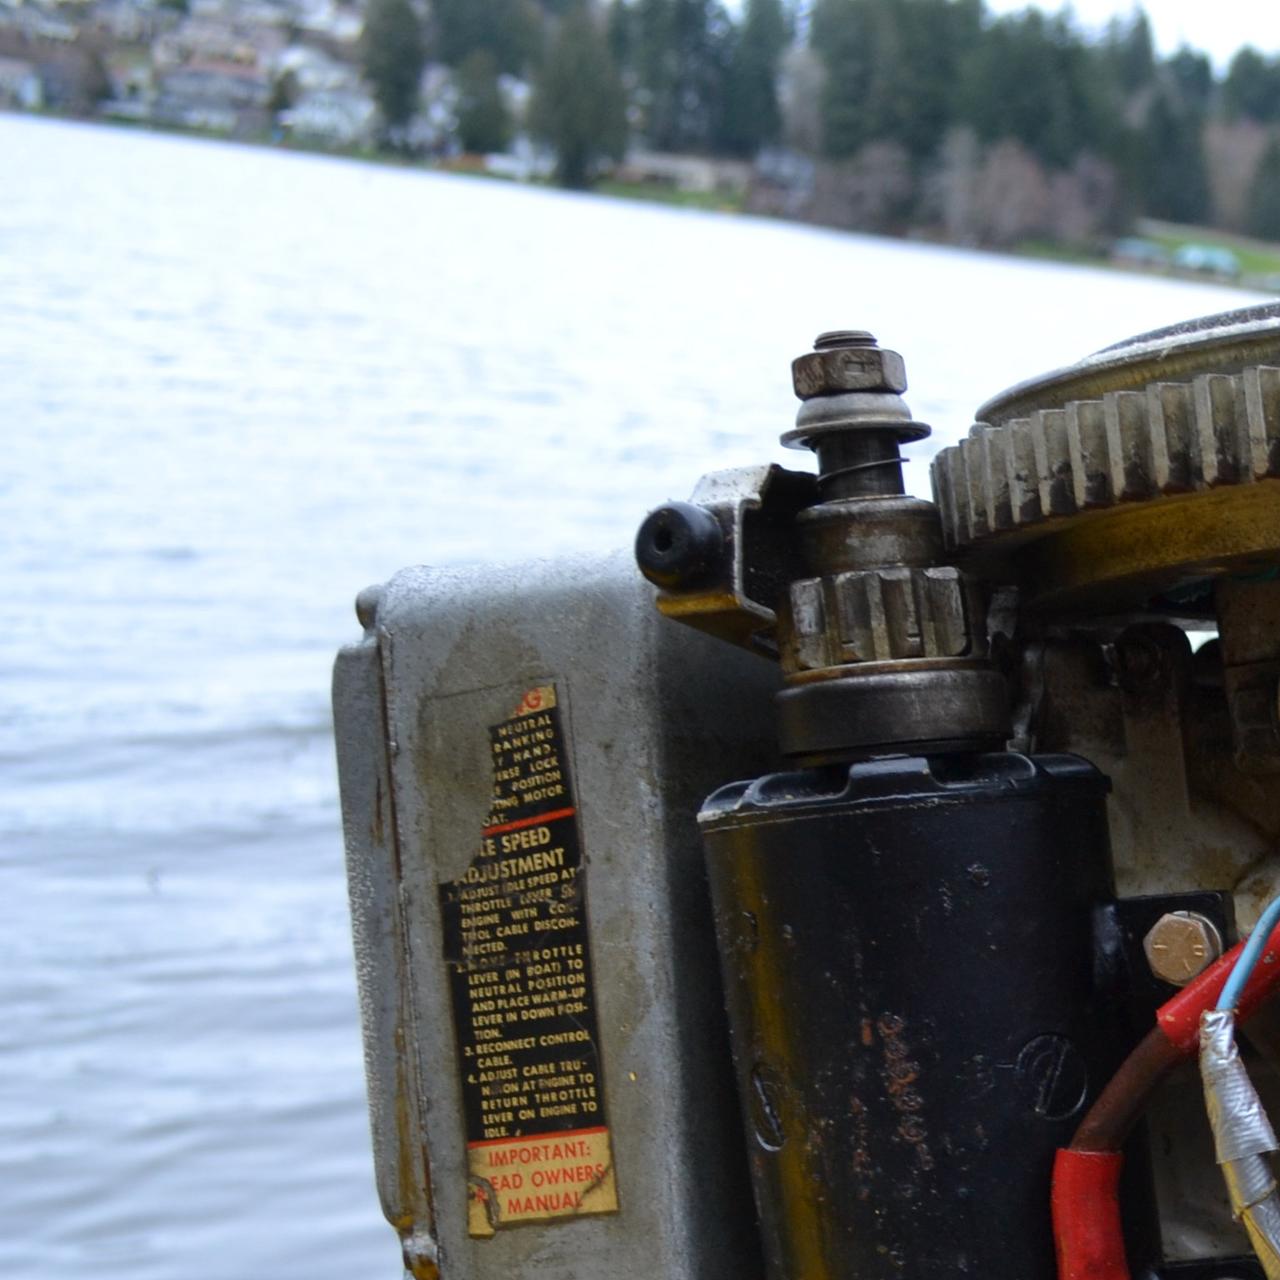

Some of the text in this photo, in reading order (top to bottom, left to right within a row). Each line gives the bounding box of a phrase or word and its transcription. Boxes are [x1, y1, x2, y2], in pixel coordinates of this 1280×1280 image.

[498, 715, 552, 736] NEUTRAL
[513, 748, 557, 762] HAND.
[530, 757, 559, 772] LOCK
[512, 771, 562, 791] POSITION
[502, 827, 551, 852] SPEED
[461, 886, 499, 900] ADJUST
[528, 872, 558, 889] SPEED
[561, 867, 576, 879] AT
[460, 898, 512, 914] THROTTLE
[461, 913, 500, 928] ENGINE
[511, 908, 538, 920] WITH
[496, 921, 529, 936] CABLE
[534, 918, 580, 931] DISCON-
[515, 944, 583, 963] THROTTLE
[468, 971, 499, 985] LEVER
[527, 962, 562, 977] BOAT)
[567, 959, 584, 971] TO
[469, 973, 586, 999] NEUTRAL POSITION
[472, 987, 586, 1012] AND PLACE WARM-UP
[472, 1012, 503, 1027] LEVER
[506, 1010, 517, 1021] IN
[521, 1006, 555, 1020] DOWN
[464, 1030, 591, 1057] 3. RECONNECT CONTROL
[473, 1027, 503, 1040] TION.
[467, 1060, 588, 1084] 4. ADJUST CABLE TRU-
[477, 1056, 513, 1068] CABLE.
[481, 1074, 594, 1096] NON AT ENGINE TO
[481, 1088, 596, 1110] RETURN THROTTLE
[483, 1102, 598, 1125] LEVER ON ENGINE TO
[484, 1128, 509, 1138] IDLE.
[489, 1140, 591, 1167] IMPORTANT:
[531, 1164, 608, 1187] OWNERS
[508, 1192, 585, 1215] MANUAL
